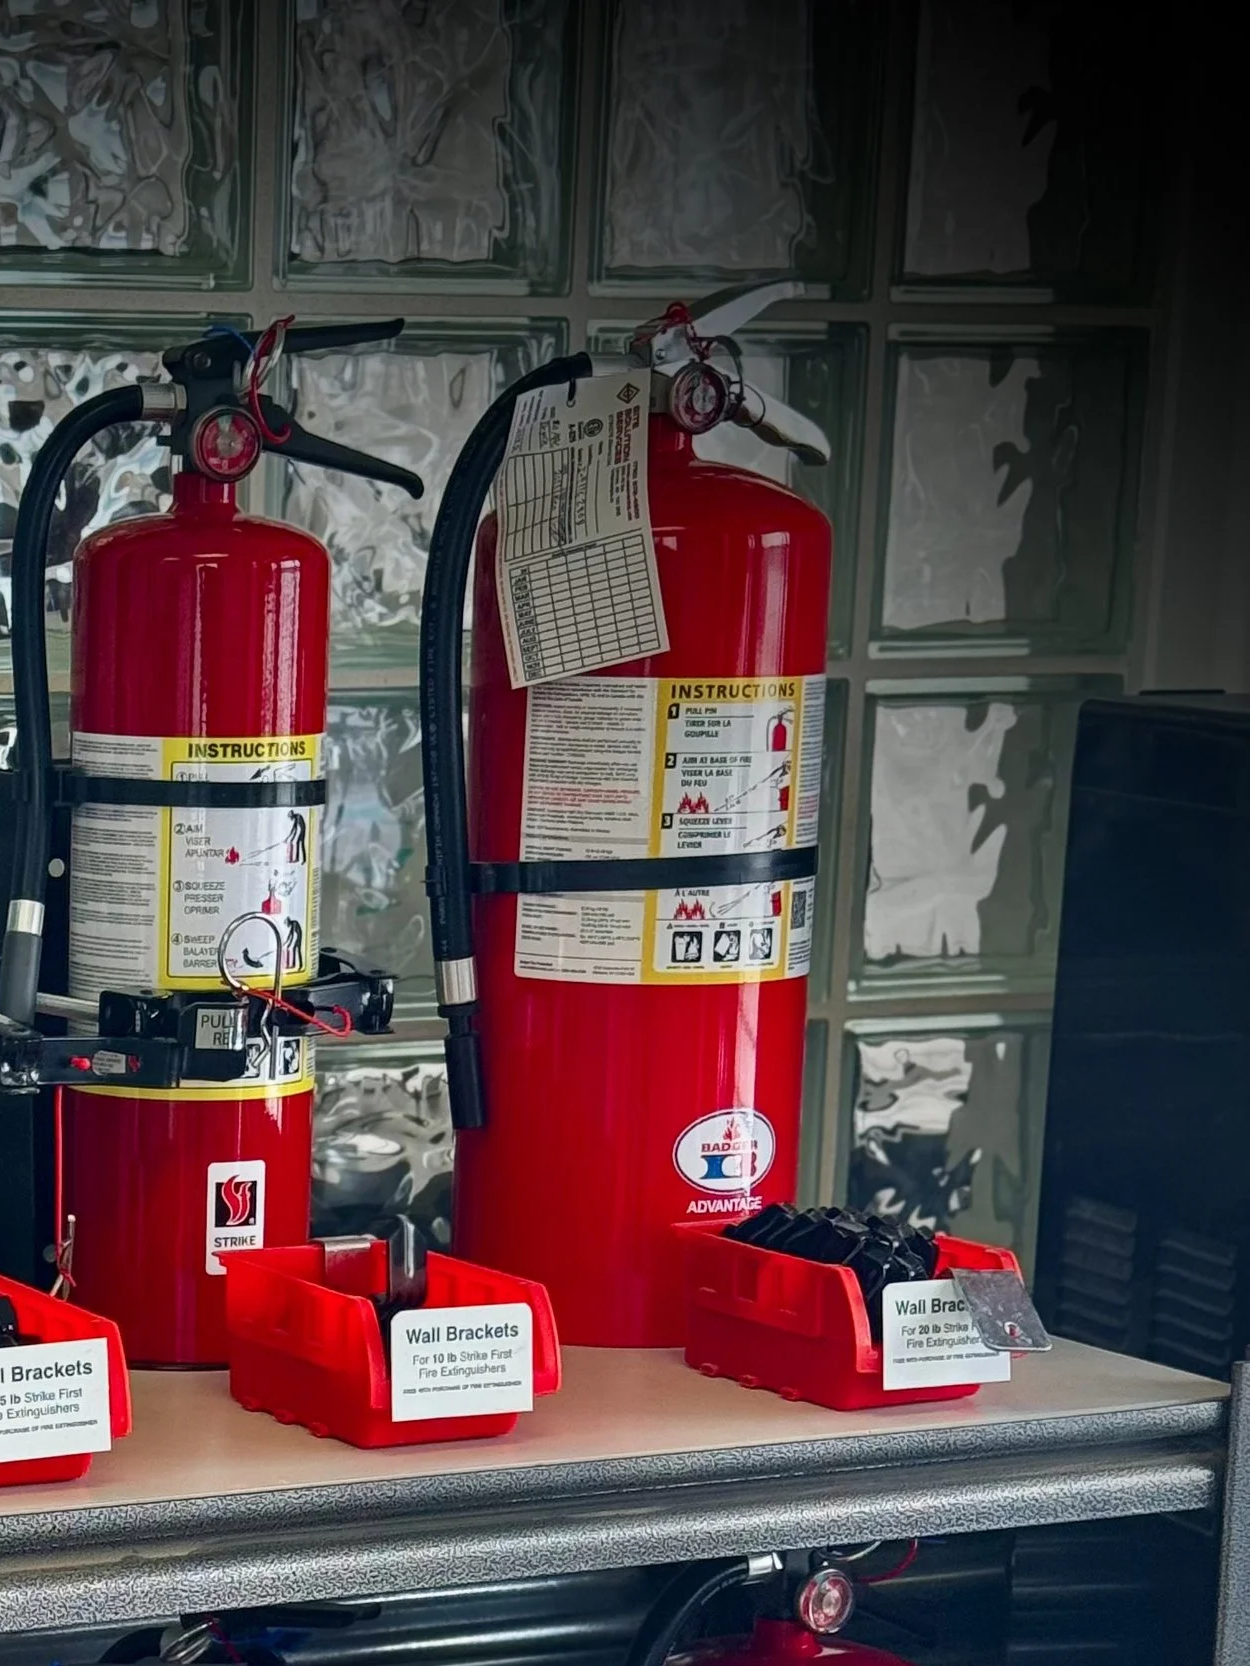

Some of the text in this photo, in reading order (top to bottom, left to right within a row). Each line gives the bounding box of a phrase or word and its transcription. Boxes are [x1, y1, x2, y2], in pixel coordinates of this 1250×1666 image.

[671, 682, 795, 699] INSTRUCTIONS
[188, 741, 306, 758] INSTRUCTIONS
[185, 837, 211, 847] VISER
[185, 881, 225, 891] SQUEEZE
[184, 893, 224, 903] PRESSER
[686, 1196, 762, 1214] ADVANTAGE
[214, 1236, 256, 1248] STRIKE
[895, 1300, 926, 1315] Wall
[406, 1323, 519, 1344] Wall Brackets
[902, 1323, 968, 1336] For 20 lb Strike
[907, 1338, 924, 1349] Fire
[412, 1349, 512, 1365] For 10 lb Strike First
[12, 1360, 93, 1382] Brackets
[419, 1364, 506, 1379] Fire Extinguishers
[0, 1395, 7, 1406] 5
[10, 1394, 21, 1405] lb
[24, 1391, 56, 1403] Strike
[58, 1388, 83, 1399] First
[7, 1403, 80, 1420] Extinguishers
